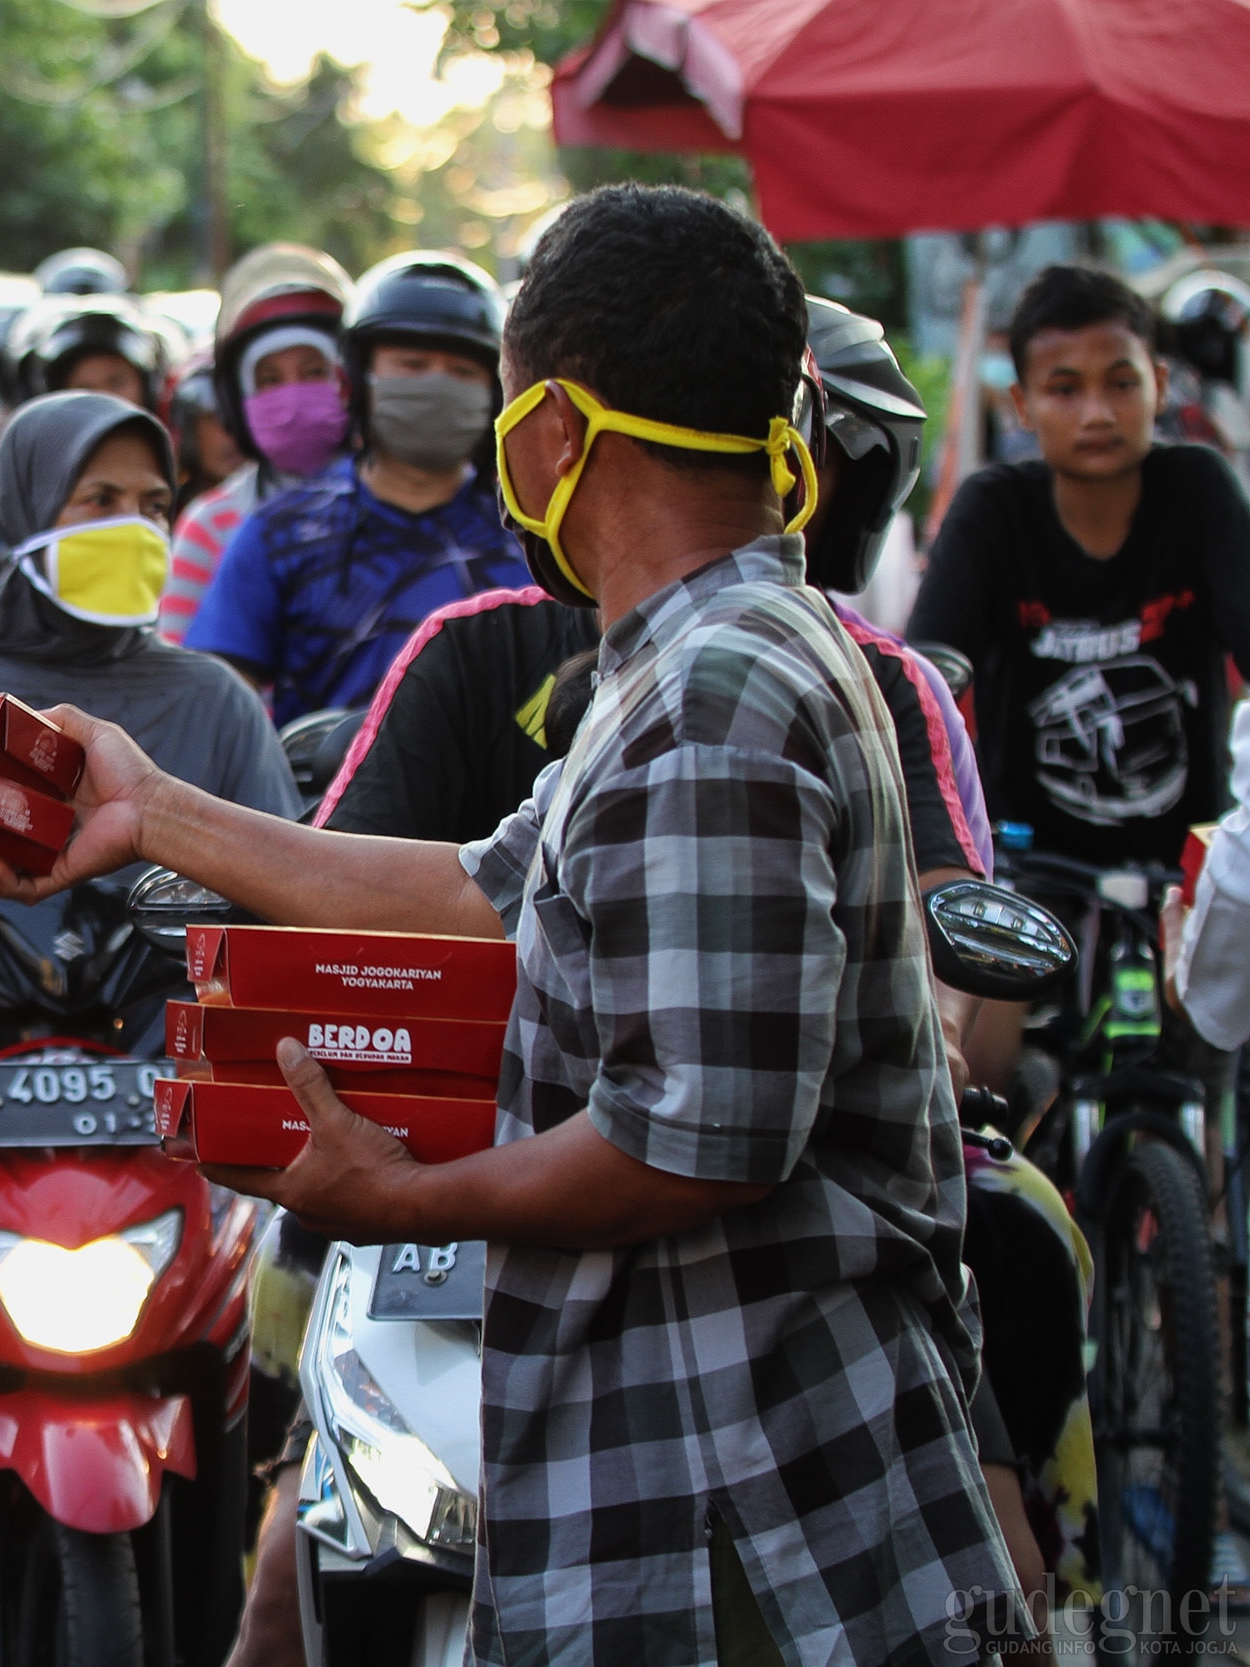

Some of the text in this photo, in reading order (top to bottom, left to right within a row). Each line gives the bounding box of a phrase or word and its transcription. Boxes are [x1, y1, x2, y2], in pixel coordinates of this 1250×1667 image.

[315, 963, 441, 981] MASJID JOGOKARIYAN
[341, 976, 414, 991] YOGYAKARTA
[308, 1023, 412, 1053] BERDOA
[9, 1065, 116, 1105] 4095
[392, 1242, 458, 1273] AB
